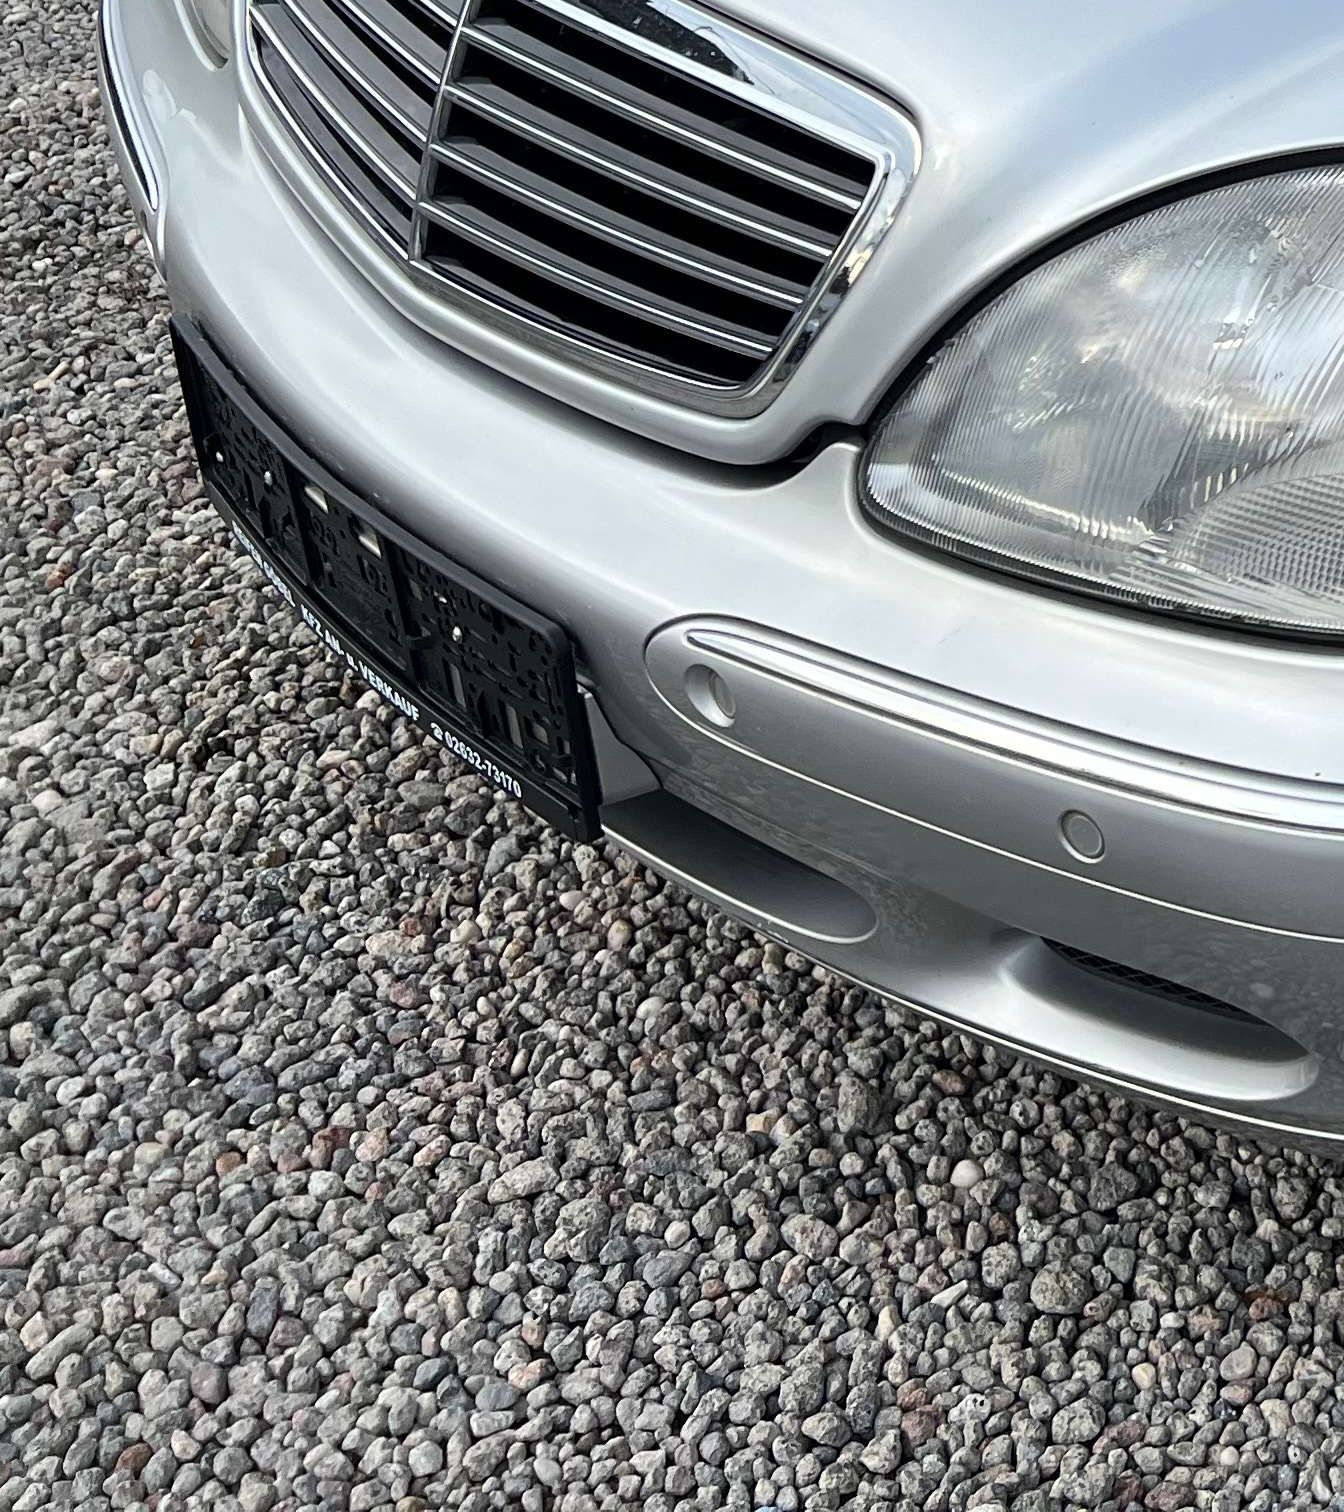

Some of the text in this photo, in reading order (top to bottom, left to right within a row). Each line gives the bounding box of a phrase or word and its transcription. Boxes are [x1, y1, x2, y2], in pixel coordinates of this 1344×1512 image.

[301, 603, 323, 637] KFZ
[359, 660, 419, 721] VERKAUF
[444, 731, 522, 798] 02632-73170
